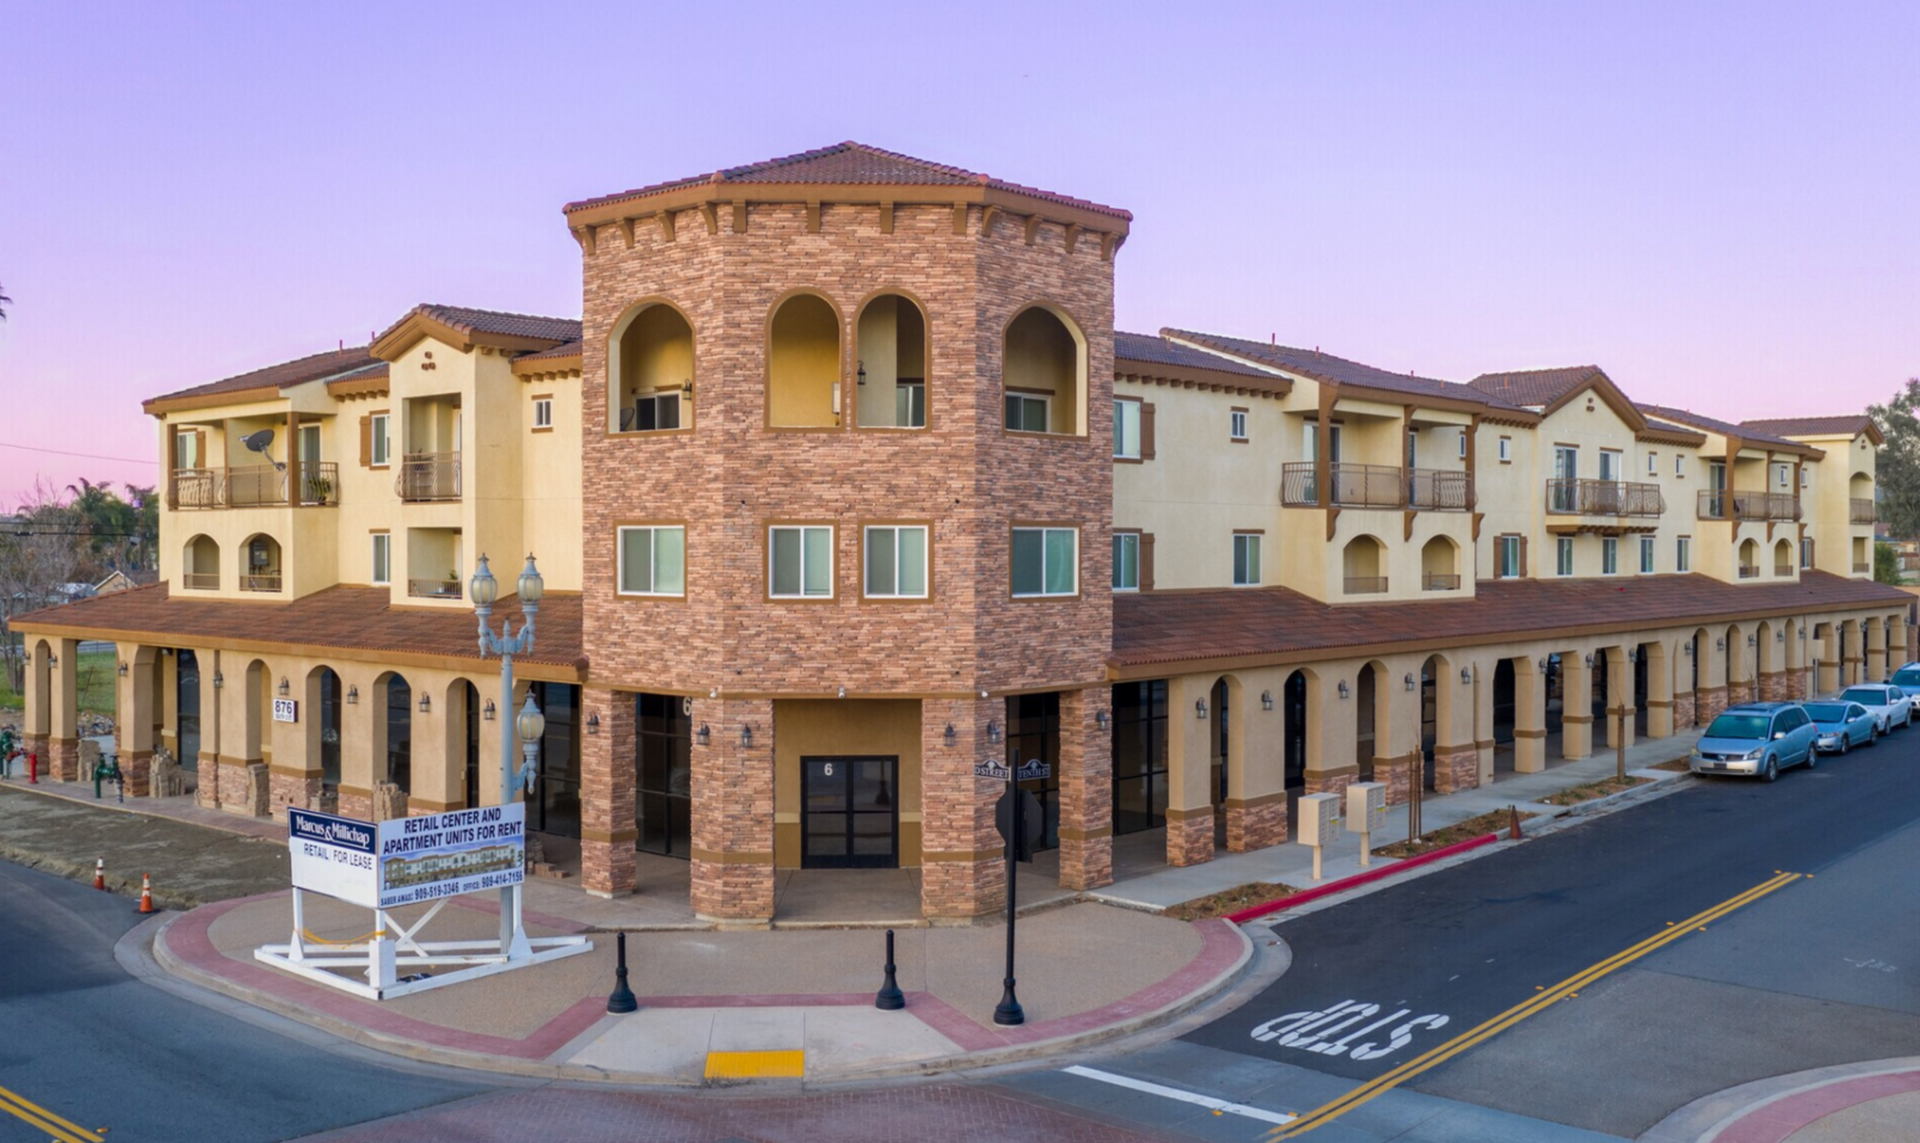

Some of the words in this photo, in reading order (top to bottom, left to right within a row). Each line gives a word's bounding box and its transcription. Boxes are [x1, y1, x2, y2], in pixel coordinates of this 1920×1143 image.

[275, 700, 293, 714] 876
[683, 696, 692, 716] 6
[823, 762, 833, 776] 6
[981, 767, 1009, 778] STREET
[1019, 768, 1041, 778] TENTH
[296, 815, 325, 835] Marcus
[332, 822, 370, 847] Millichap
[404, 818, 439, 834] RETAIL
[441, 811, 480, 829] CENTER
[481, 808, 502, 822] AND
[383, 833, 443, 855] APARTMENT
[445, 827, 475, 845] UNITS
[477, 824, 497, 840] FOR
[498, 821, 522, 837] RENT
[304, 843, 329, 860] RETAIL
[334, 849, 348, 865] FOR
[350, 854, 372, 870] LEASE
[415, 881, 460, 900] 909-519-3346
[481, 870, 523, 888] 909-414-7156
[1250, 999, 1450, 1060] STOP
